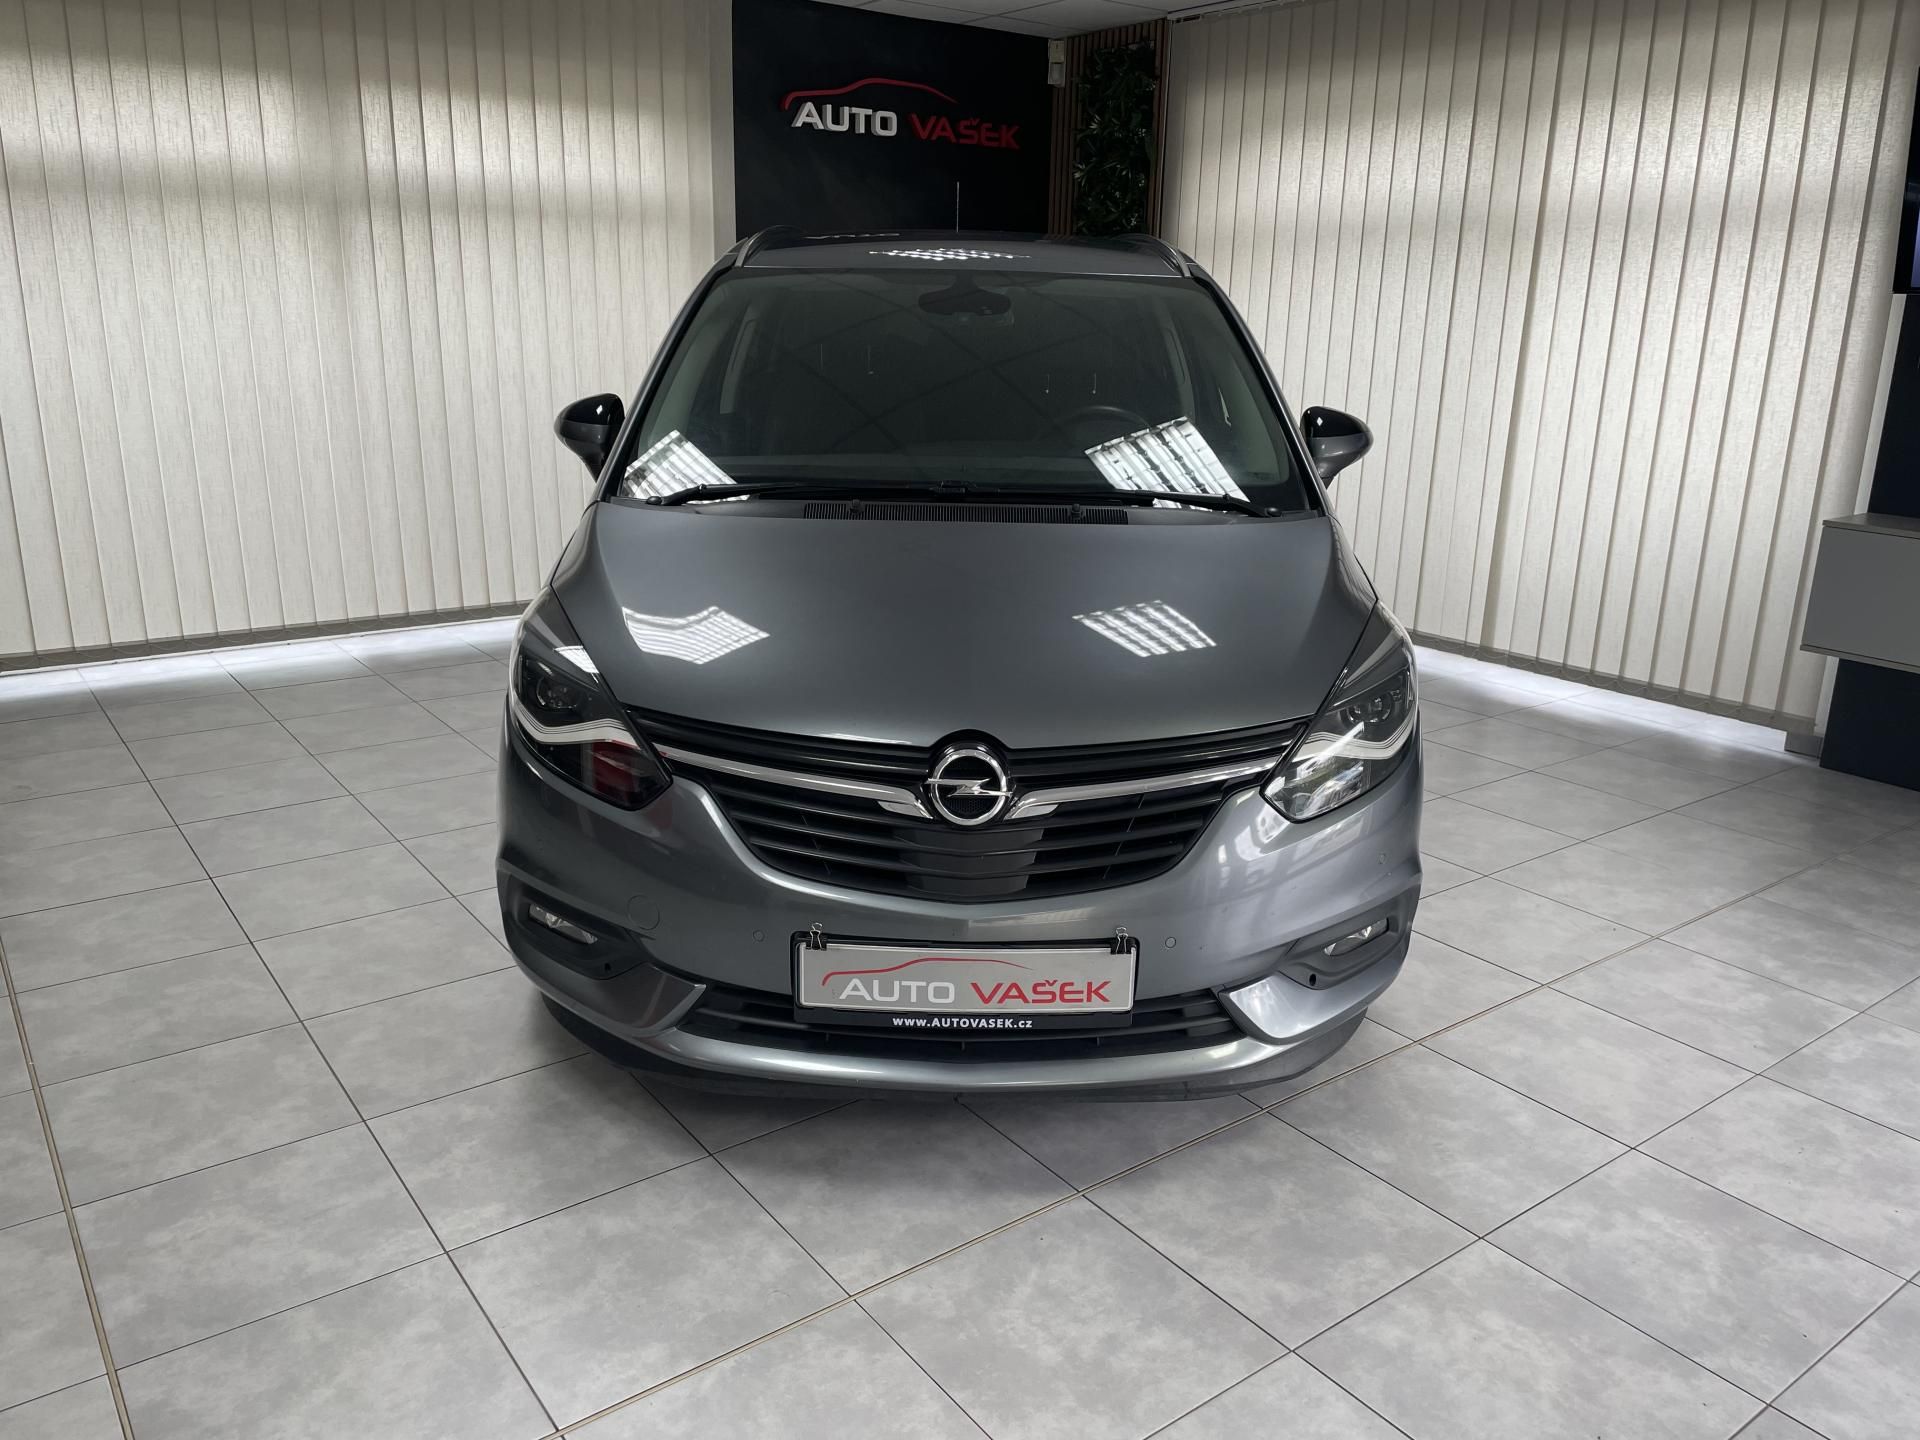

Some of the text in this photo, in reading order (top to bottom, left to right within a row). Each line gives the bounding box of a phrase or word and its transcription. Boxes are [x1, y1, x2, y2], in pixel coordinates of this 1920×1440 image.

[791, 101, 1020, 149] AUTO VAŠEK
[839, 977, 1111, 1005] AUTO VAŠEK
[892, 1017, 1033, 1029] www.AUTOVASEK.cz
